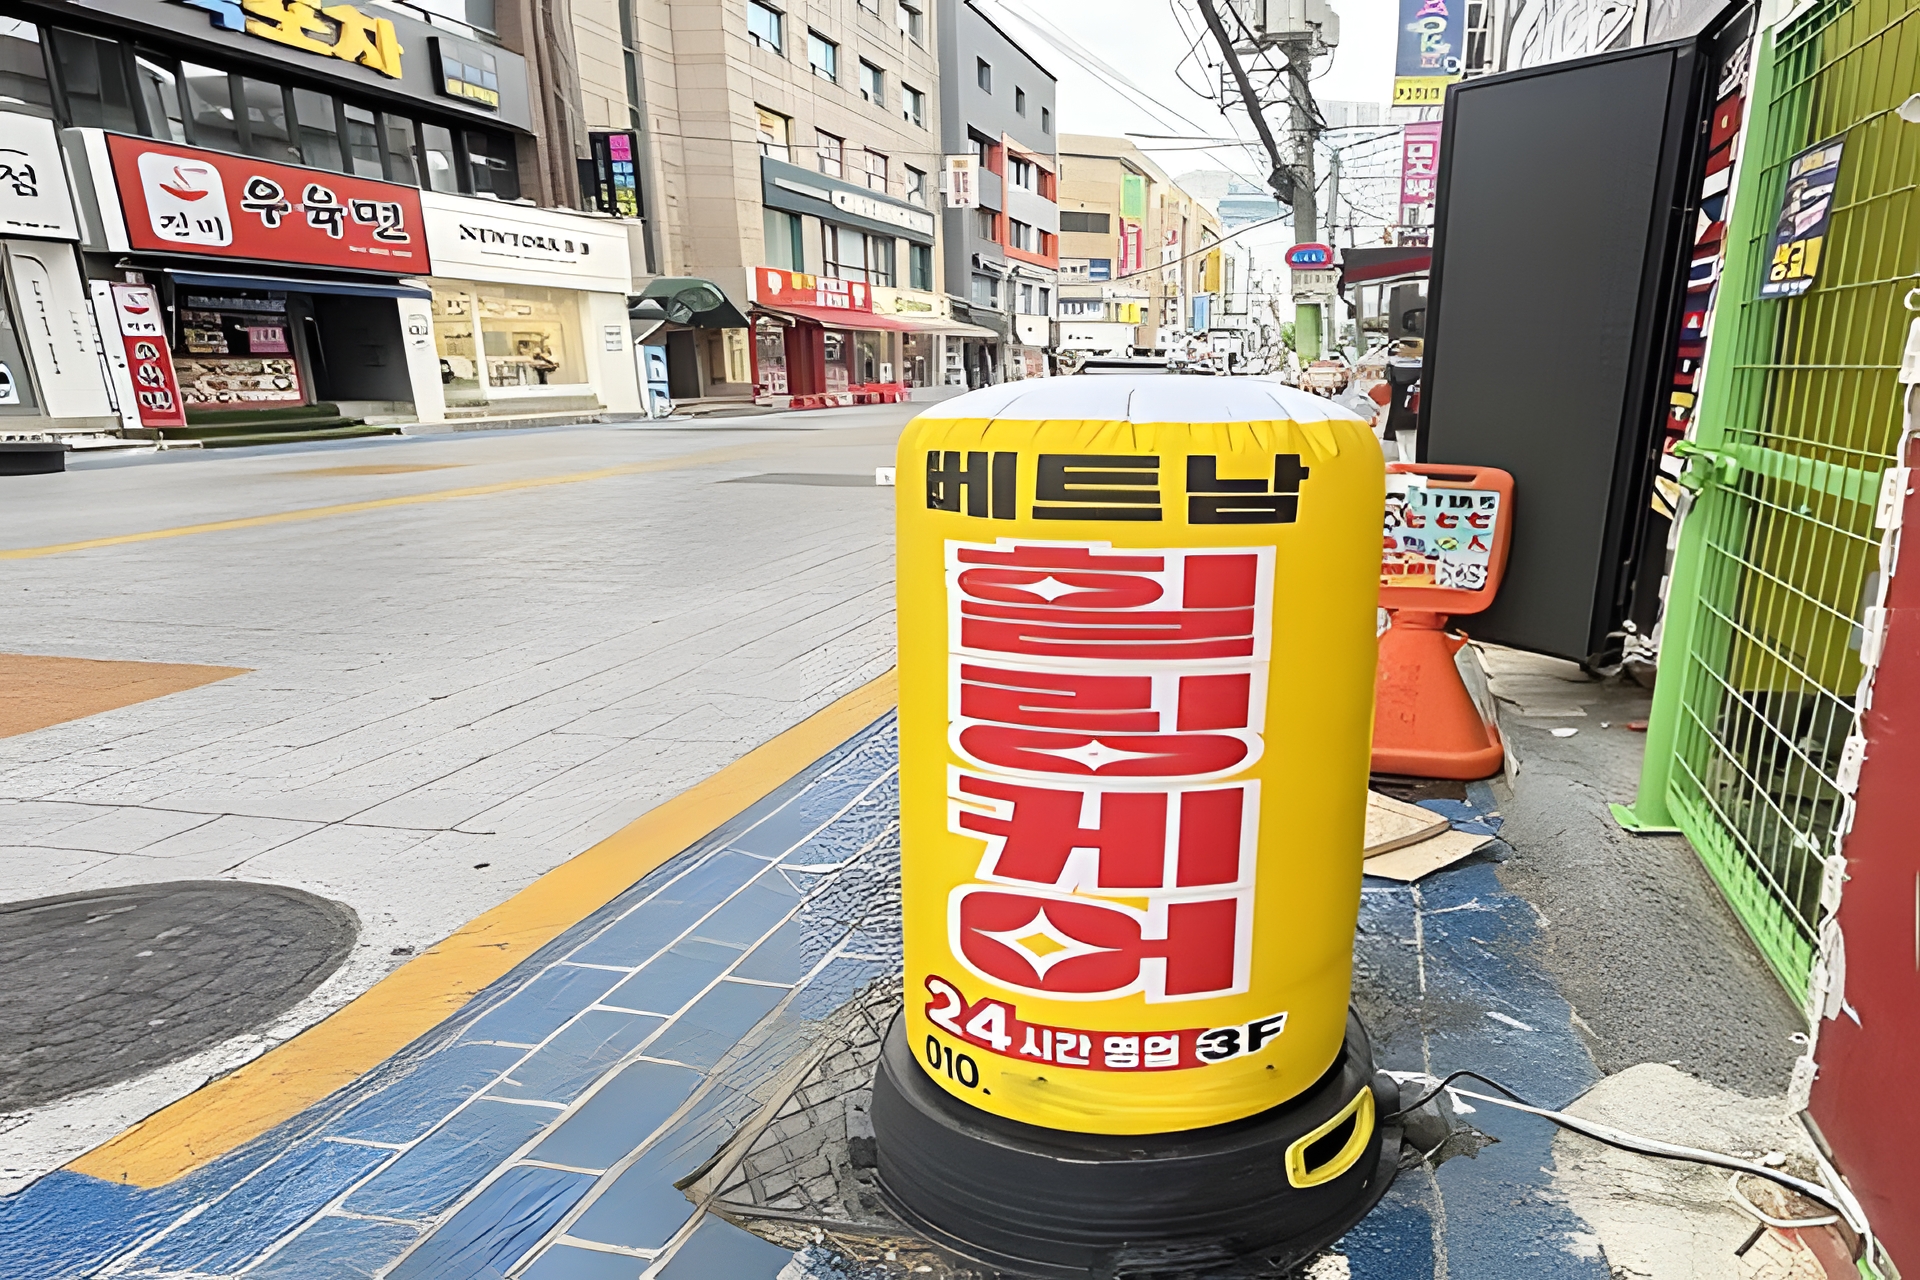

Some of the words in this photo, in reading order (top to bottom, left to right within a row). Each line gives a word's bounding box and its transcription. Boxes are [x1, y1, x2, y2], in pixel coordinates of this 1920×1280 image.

[926, 450, 1310, 524] 베트남
[925, 975, 1093, 1067] 24시간
[1196, 1011, 1289, 1065] 3F
